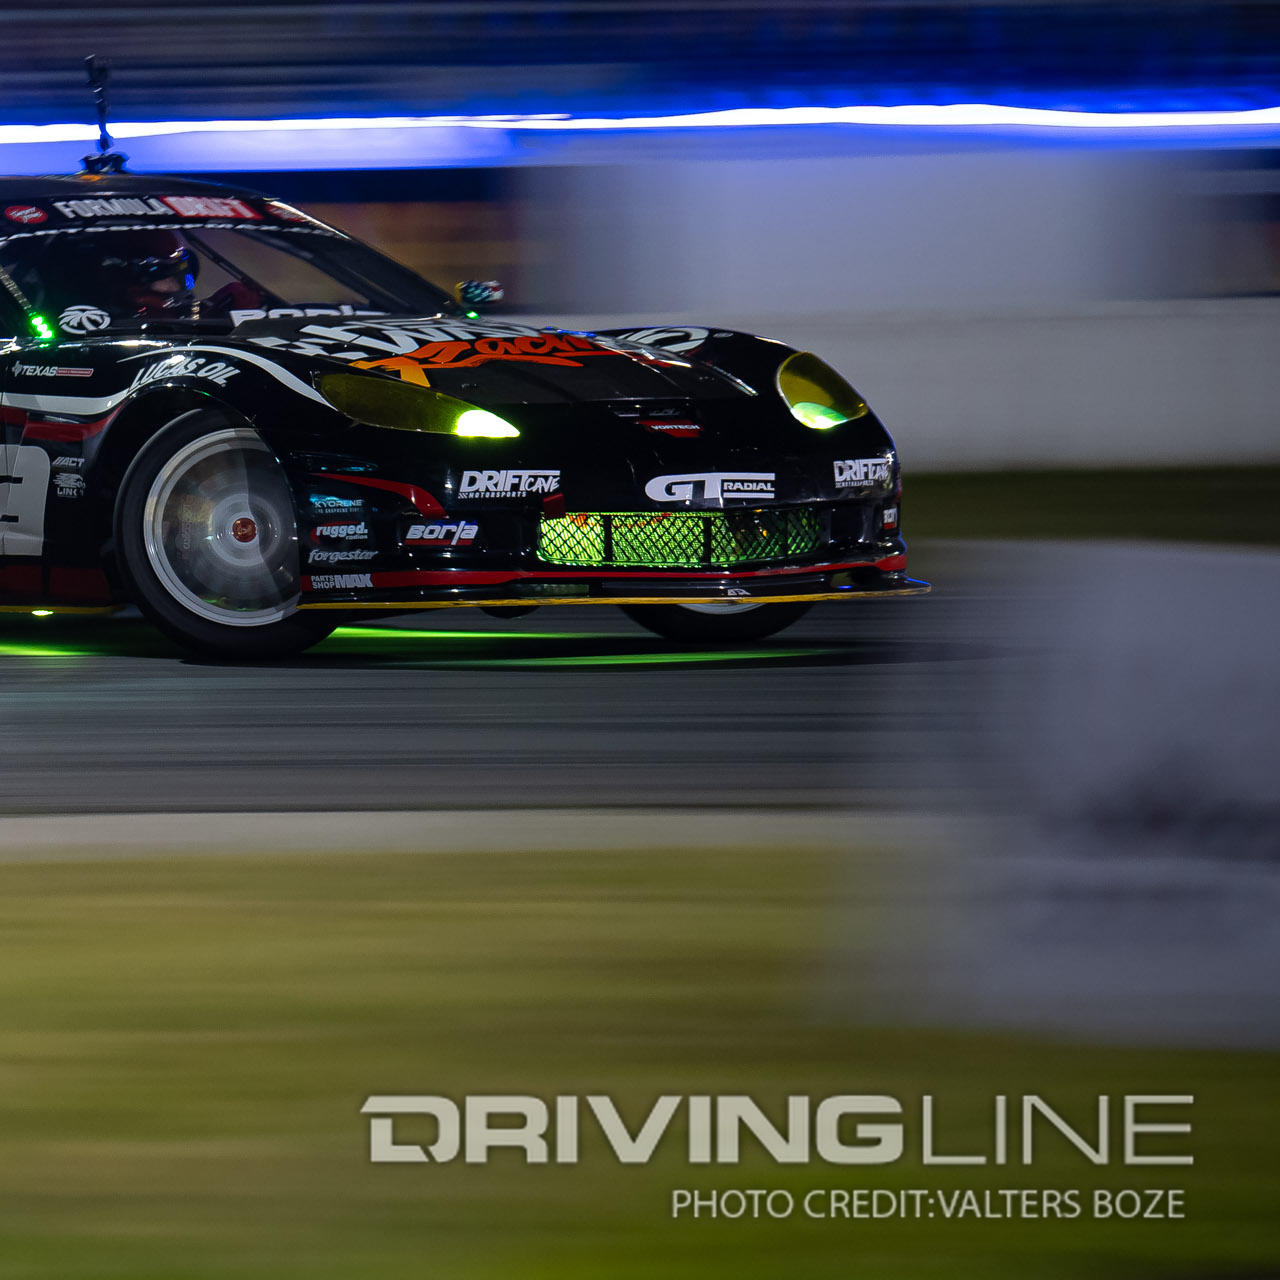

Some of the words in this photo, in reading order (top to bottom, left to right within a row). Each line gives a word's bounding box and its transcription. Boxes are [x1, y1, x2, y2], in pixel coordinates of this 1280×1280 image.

[53, 197, 175, 219] FORMULA
[21, 364, 57, 377] TEXAS
[129, 355, 206, 391] LUCAS
[198, 360, 241, 387] OIL
[650, 423, 701, 431] VORTECH
[833, 458, 876, 482] DRIFT
[459, 470, 532, 492] DRIFT
[525, 476, 561, 494] CAVE
[645, 472, 727, 502] GT
[723, 481, 776, 492] RADIAL
[468, 491, 527, 499] MOTORSPORTS
[307, 548, 379, 564] forgestar
[312, 581, 336, 589] SHOP
[334, 573, 374, 588] MAX
